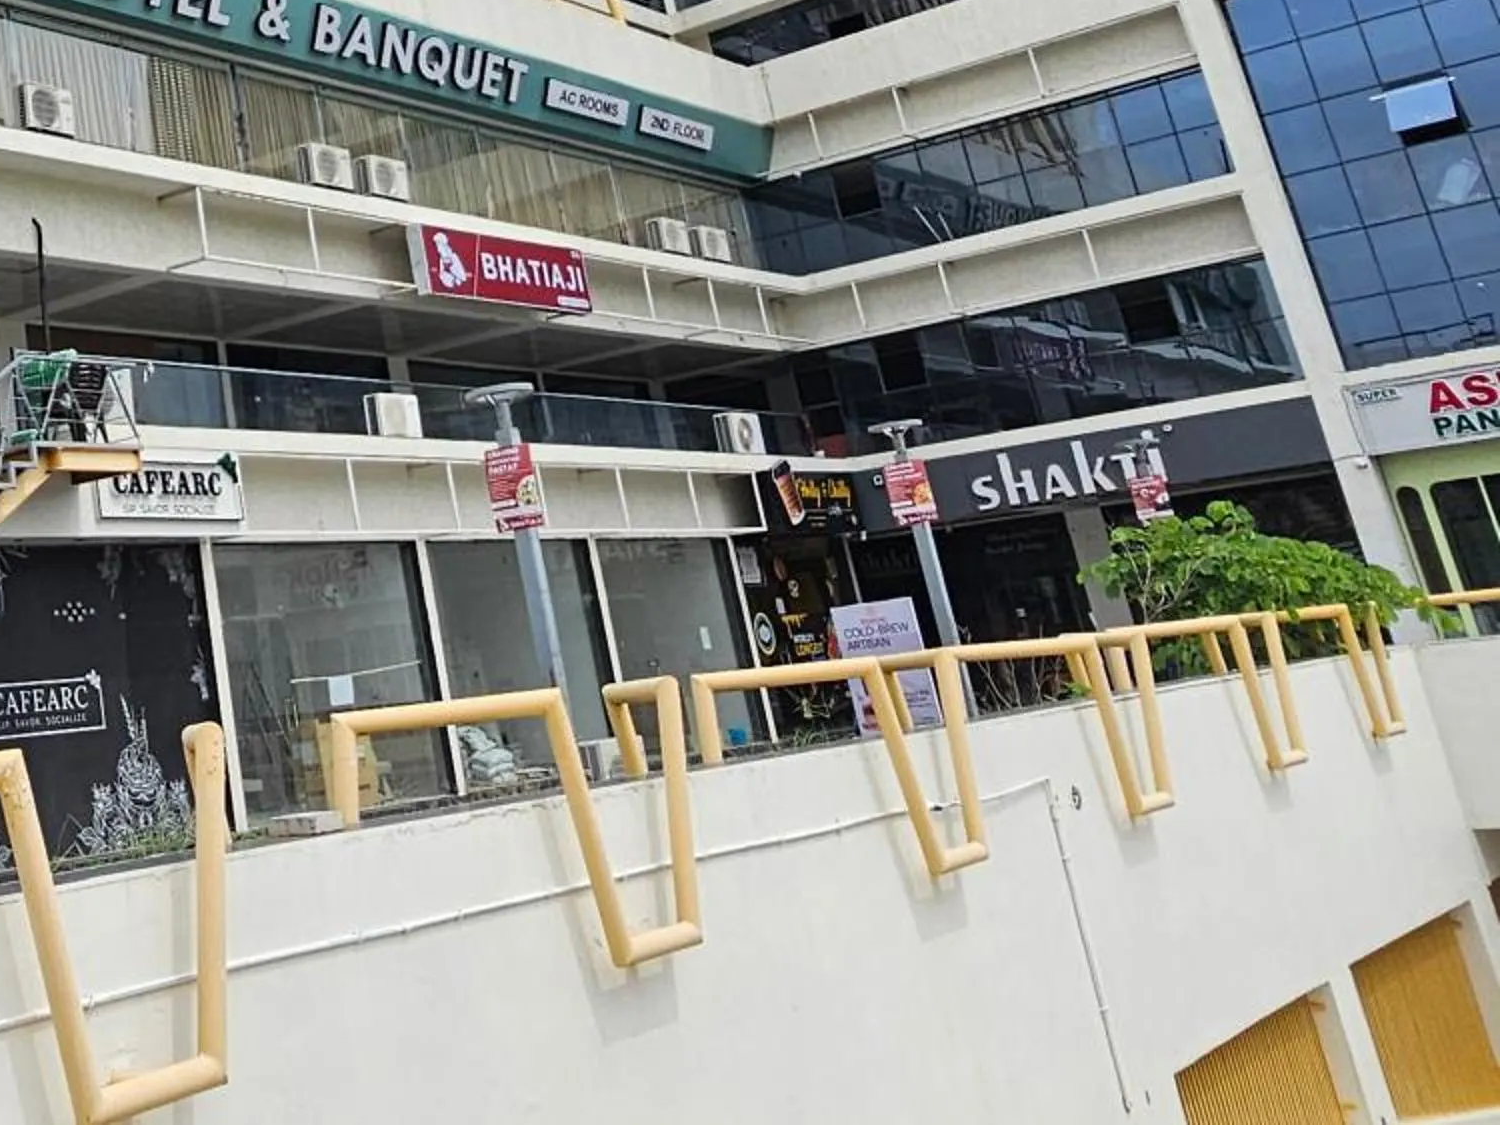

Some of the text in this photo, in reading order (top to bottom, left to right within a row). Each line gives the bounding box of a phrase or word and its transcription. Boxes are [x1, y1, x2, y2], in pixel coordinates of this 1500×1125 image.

[313, 2, 529, 104] BANQUET
[559, 89, 619, 118] AC ROOMS
[650, 114, 705, 142] 2ND FLOOR
[480, 252, 585, 293] BHATIAJI
[1356, 388, 1398, 403] SUPER
[1429, 370, 1500, 414] AS
[112, 470, 223, 496] CAFEARC
